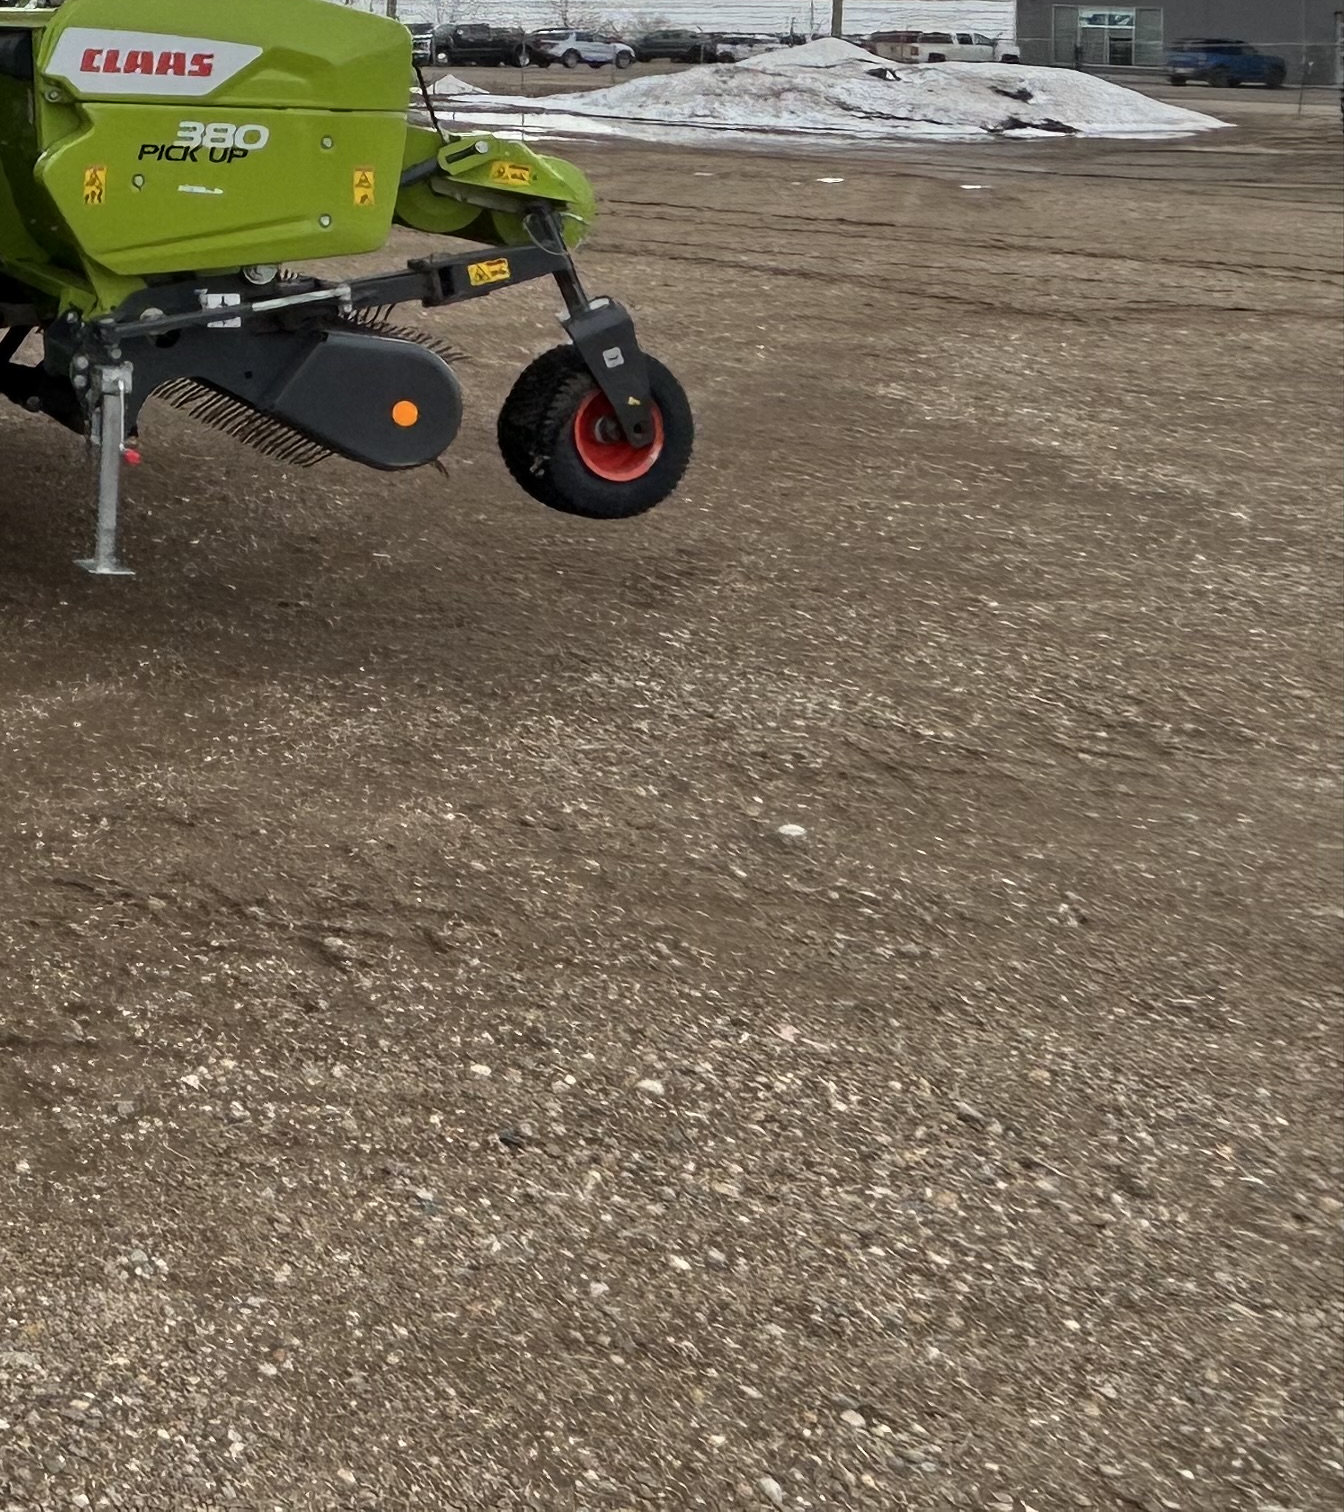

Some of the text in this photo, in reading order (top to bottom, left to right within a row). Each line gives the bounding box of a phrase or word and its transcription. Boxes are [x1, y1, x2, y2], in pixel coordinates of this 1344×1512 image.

[79, 48, 214, 77] CLAAS
[173, 120, 269, 150] 380
[138, 144, 248, 164] PICK UP
